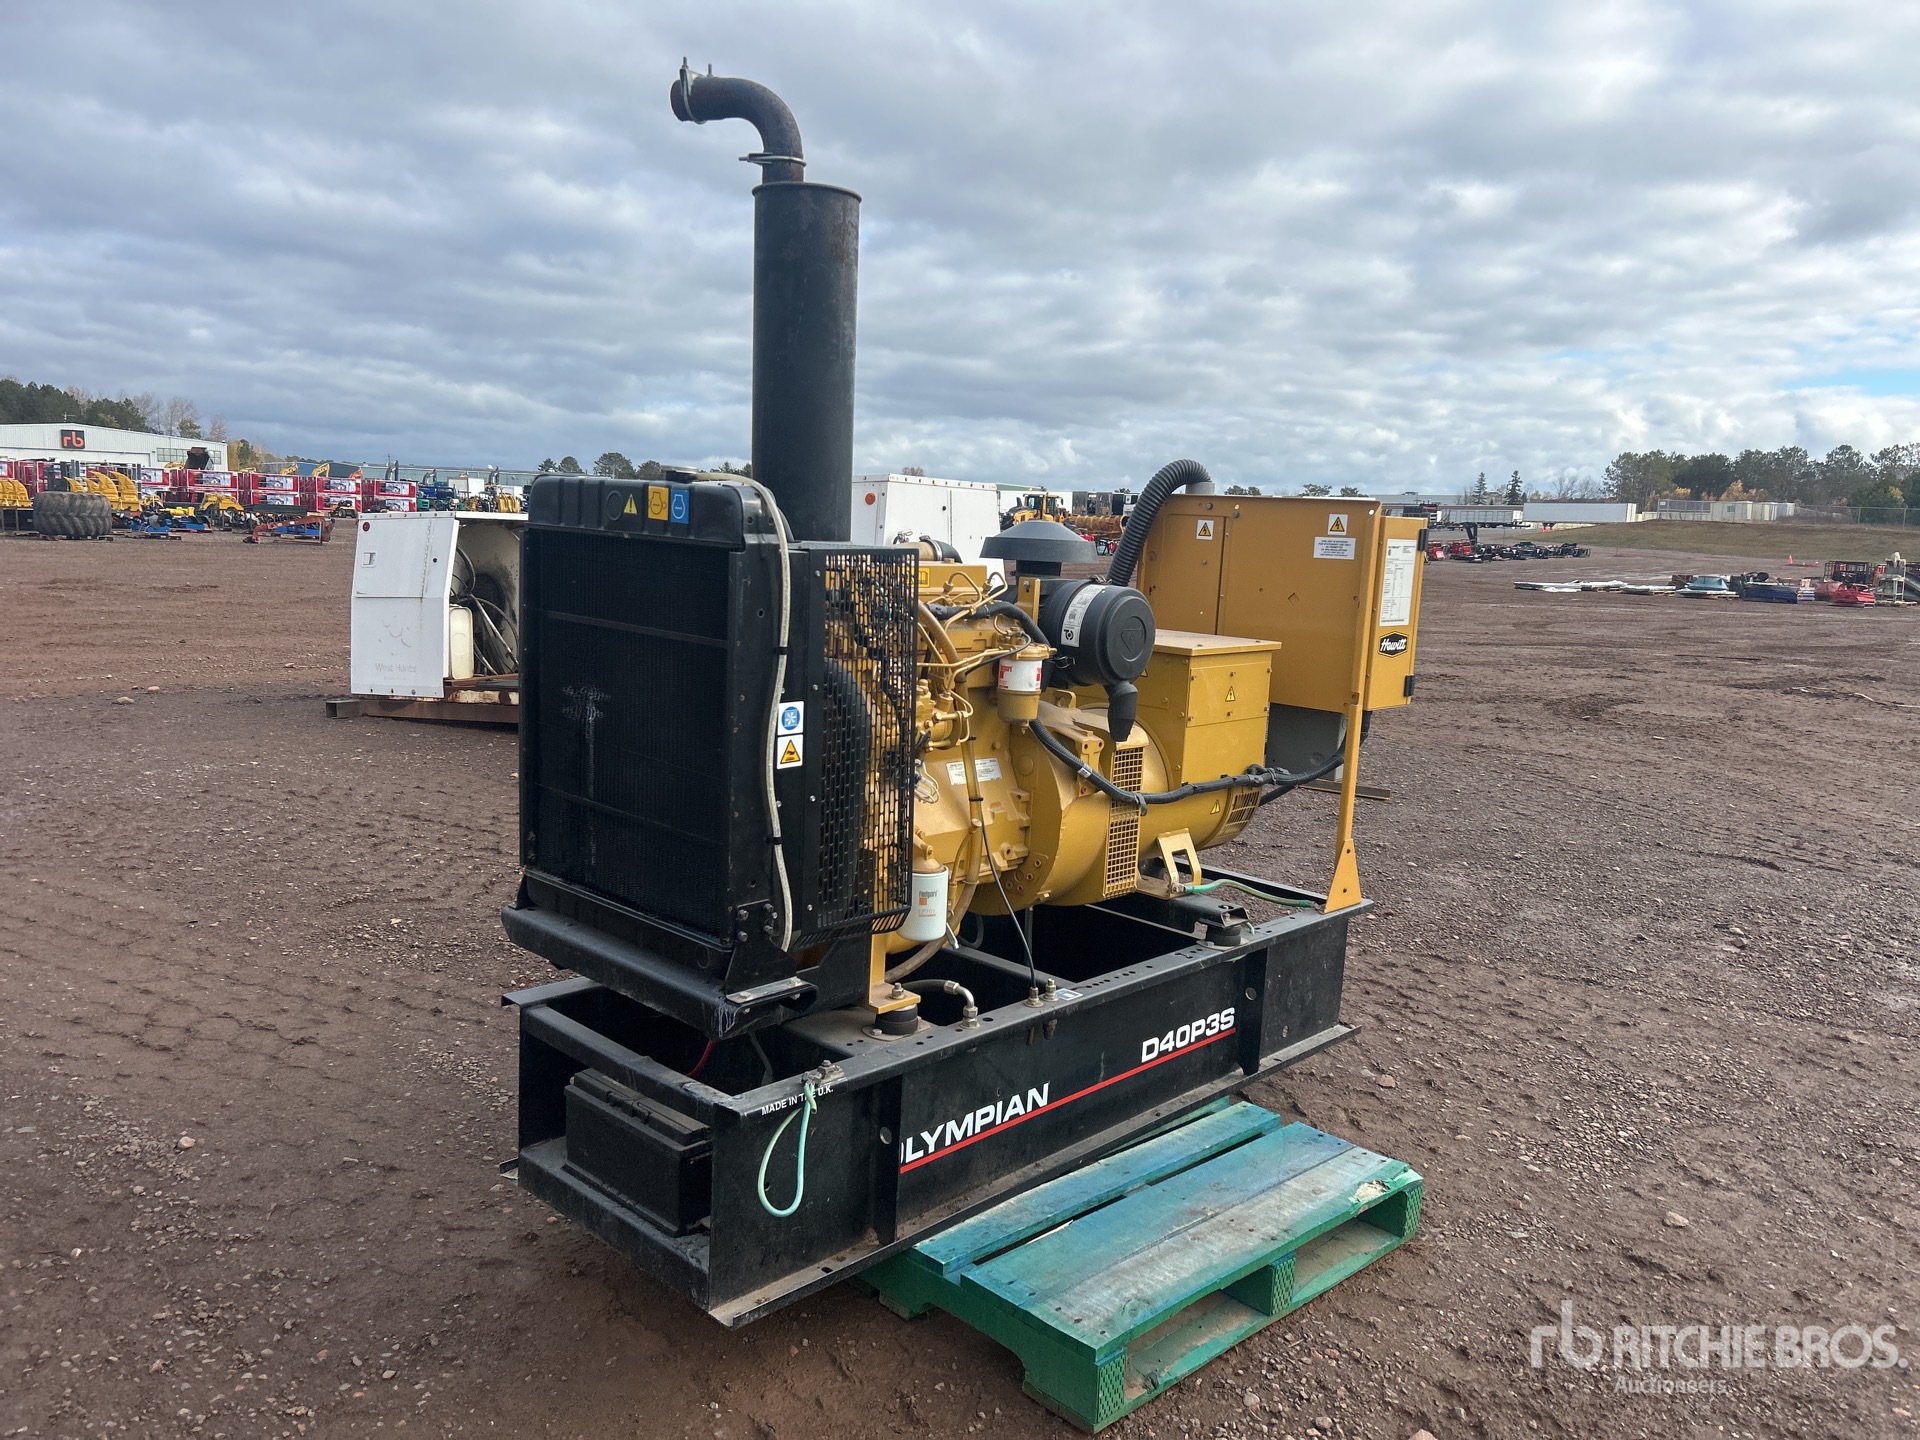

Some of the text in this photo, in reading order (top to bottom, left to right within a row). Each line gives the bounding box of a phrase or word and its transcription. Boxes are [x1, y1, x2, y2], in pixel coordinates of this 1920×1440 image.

[63, 431, 84, 447] rb
[1380, 638, 1407, 651] Hewitt
[1141, 1007, 1235, 1063] D40P3S
[761, 1084, 834, 1116] MADE IN TE U.K.
[900, 1082, 1050, 1163] LYMPIAN
